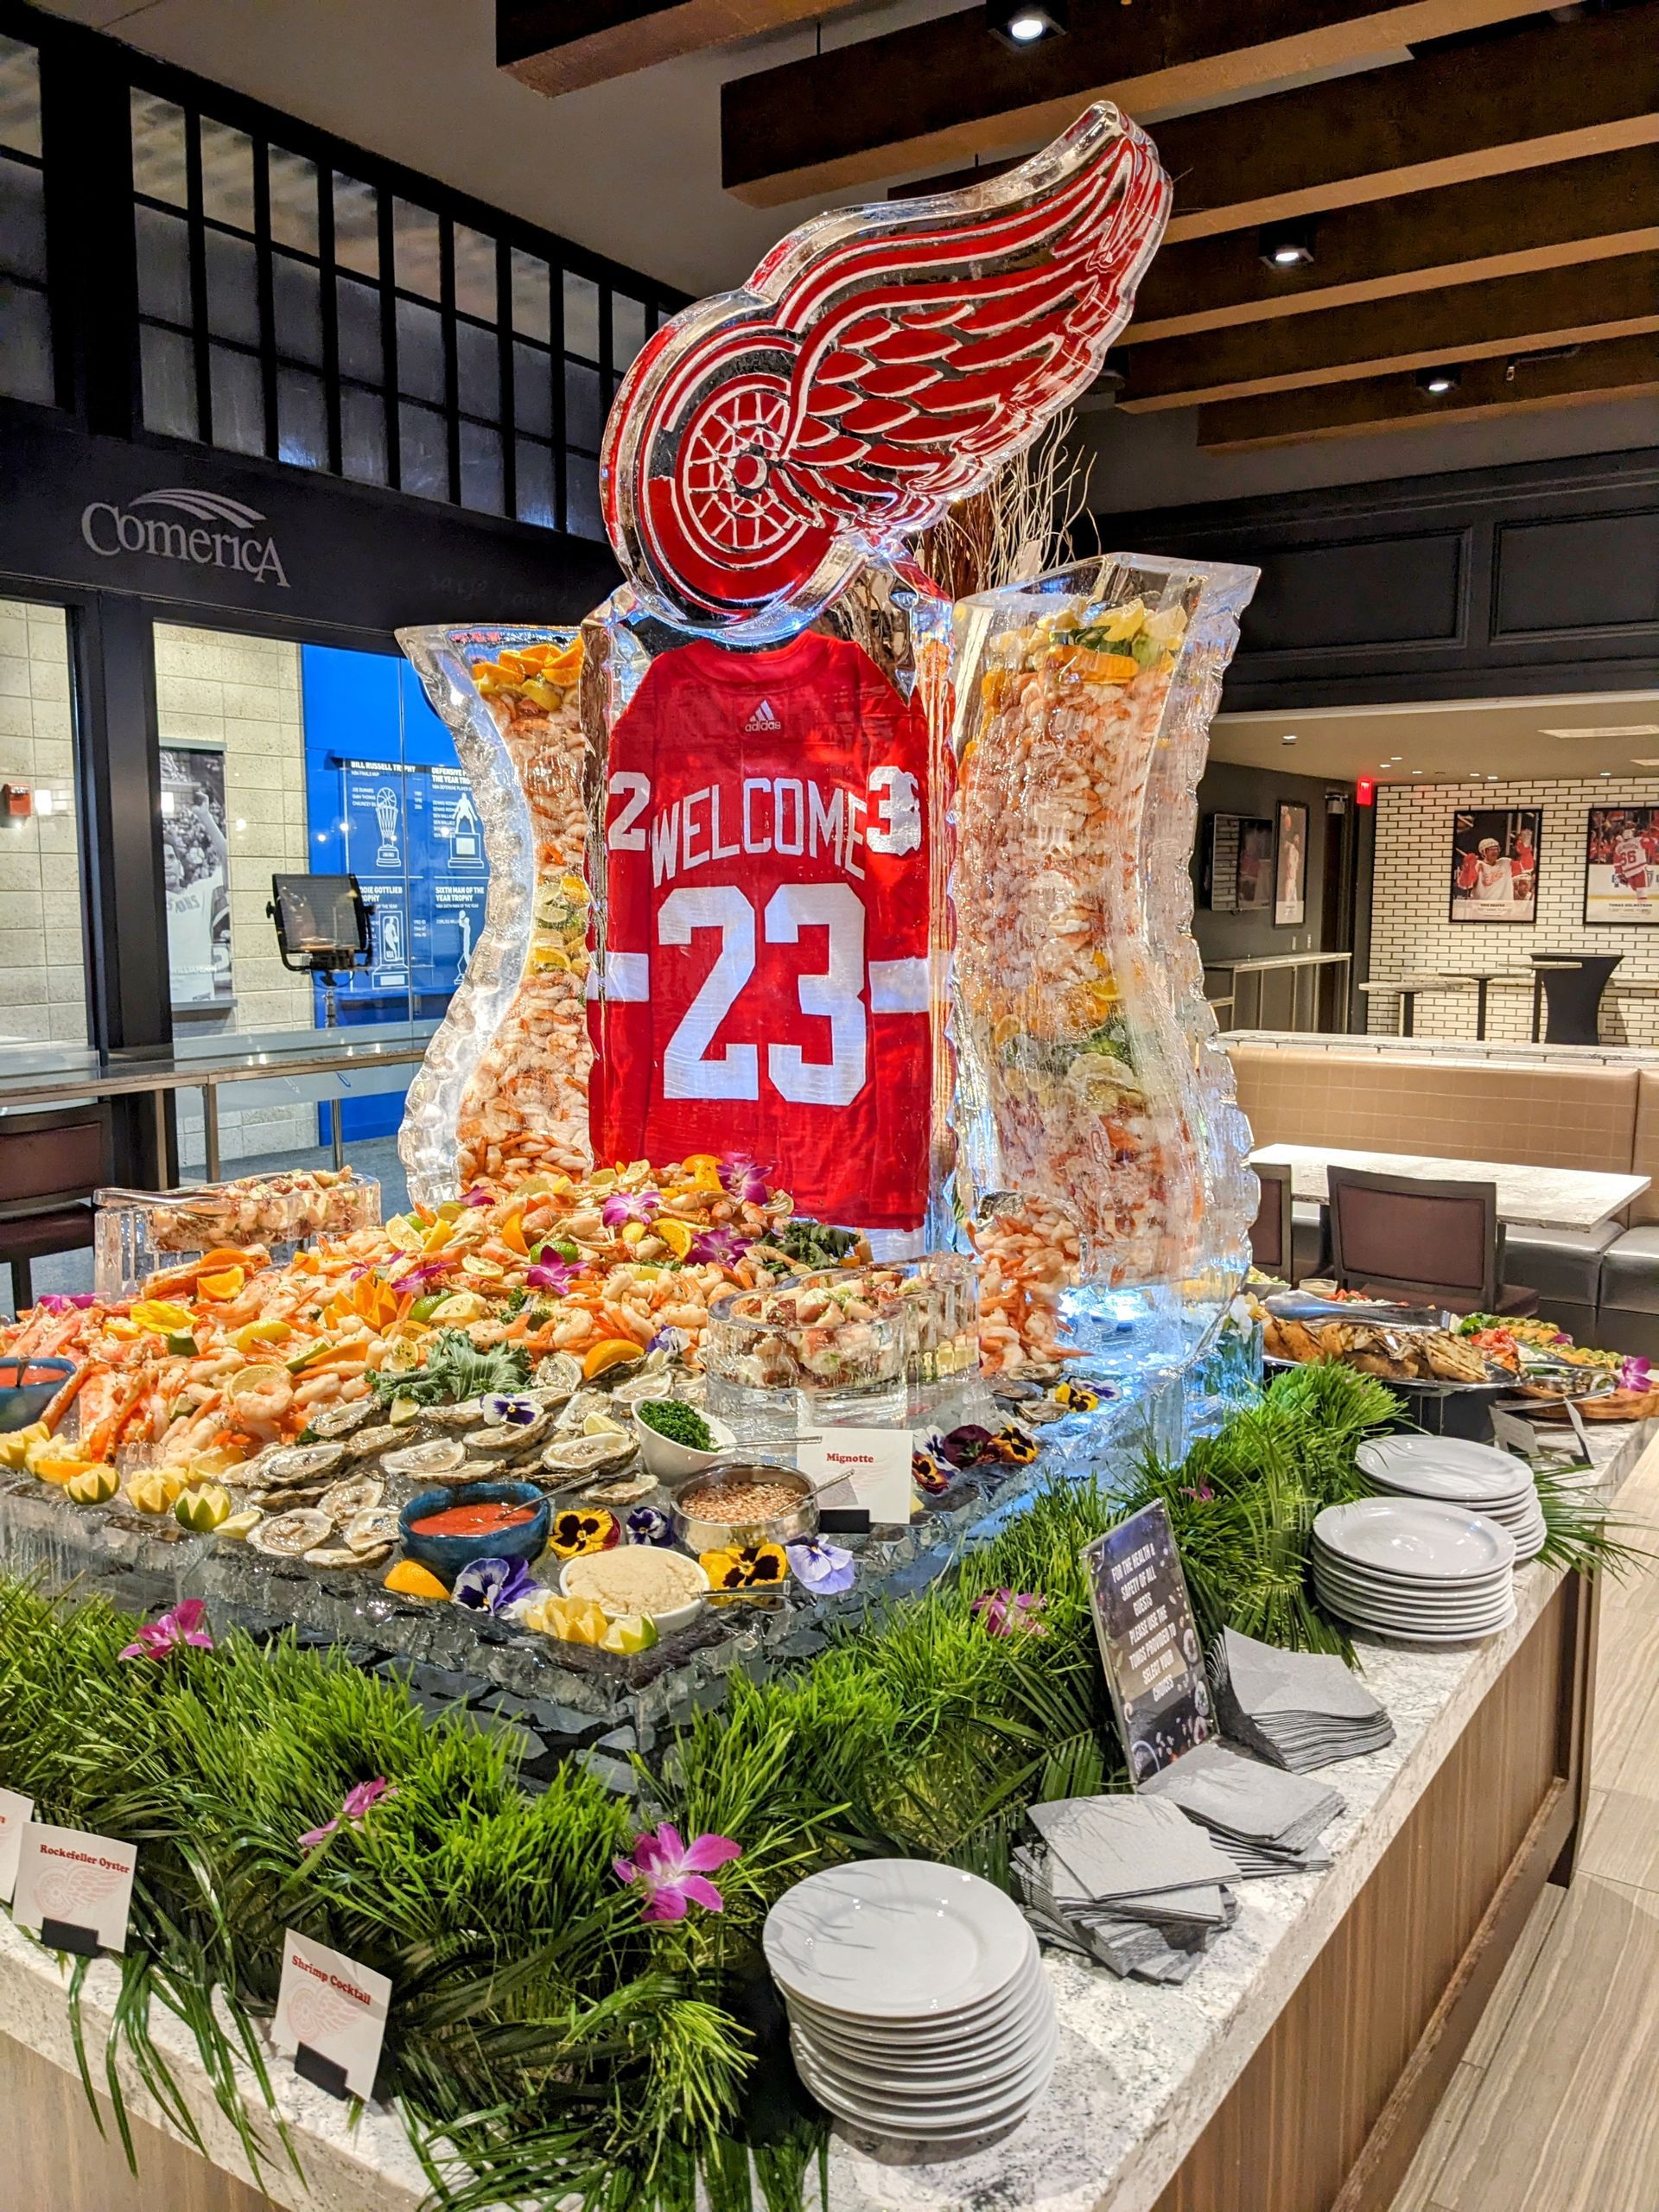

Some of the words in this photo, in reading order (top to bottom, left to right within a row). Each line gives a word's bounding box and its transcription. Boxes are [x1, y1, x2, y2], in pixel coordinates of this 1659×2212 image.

[745, 721, 781, 732] adidas
[350, 760, 365, 769] BILL
[365, 761, 392, 771] RUSSELL
[392, 764, 416, 772] TRPHY
[607, 771, 651, 851] 2
[651, 778, 867, 888] WELCOME
[658, 882, 867, 1106] 23
[826, 1452, 874, 1464] Mignotte
[1111, 1564, 1123, 1583] FOR
[1122, 1556, 1134, 1575] THE
[1131, 1543, 1152, 1569] HEALTH
[1121, 1575, 1140, 1601] SAFETY
[1139, 1571, 1147, 1588] OF
[1145, 1565, 1157, 1583] ALL
[1133, 1592, 1153, 1617] GUESTS
[1128, 1619, 1149, 1646] PLEASE
[1147, 1611, 1159, 1631] USE
[1156, 1605, 1168, 1624] THE
[1128, 1645, 1147, 1670] TONGS
[1145, 1627, 1171, 1658] PROVIDED
[1167, 1622, 1177, 1638] TO
[1142, 1660, 1161, 1686] SELECT
[1159, 1649, 1174, 1671] YOUR
[40, 1844, 98, 1865] Rockefeller
[99, 1858, 130, 1873] Oyster
[292, 1955, 328, 1982] Shrimp
[330, 1974, 372, 2005] Cocktail
